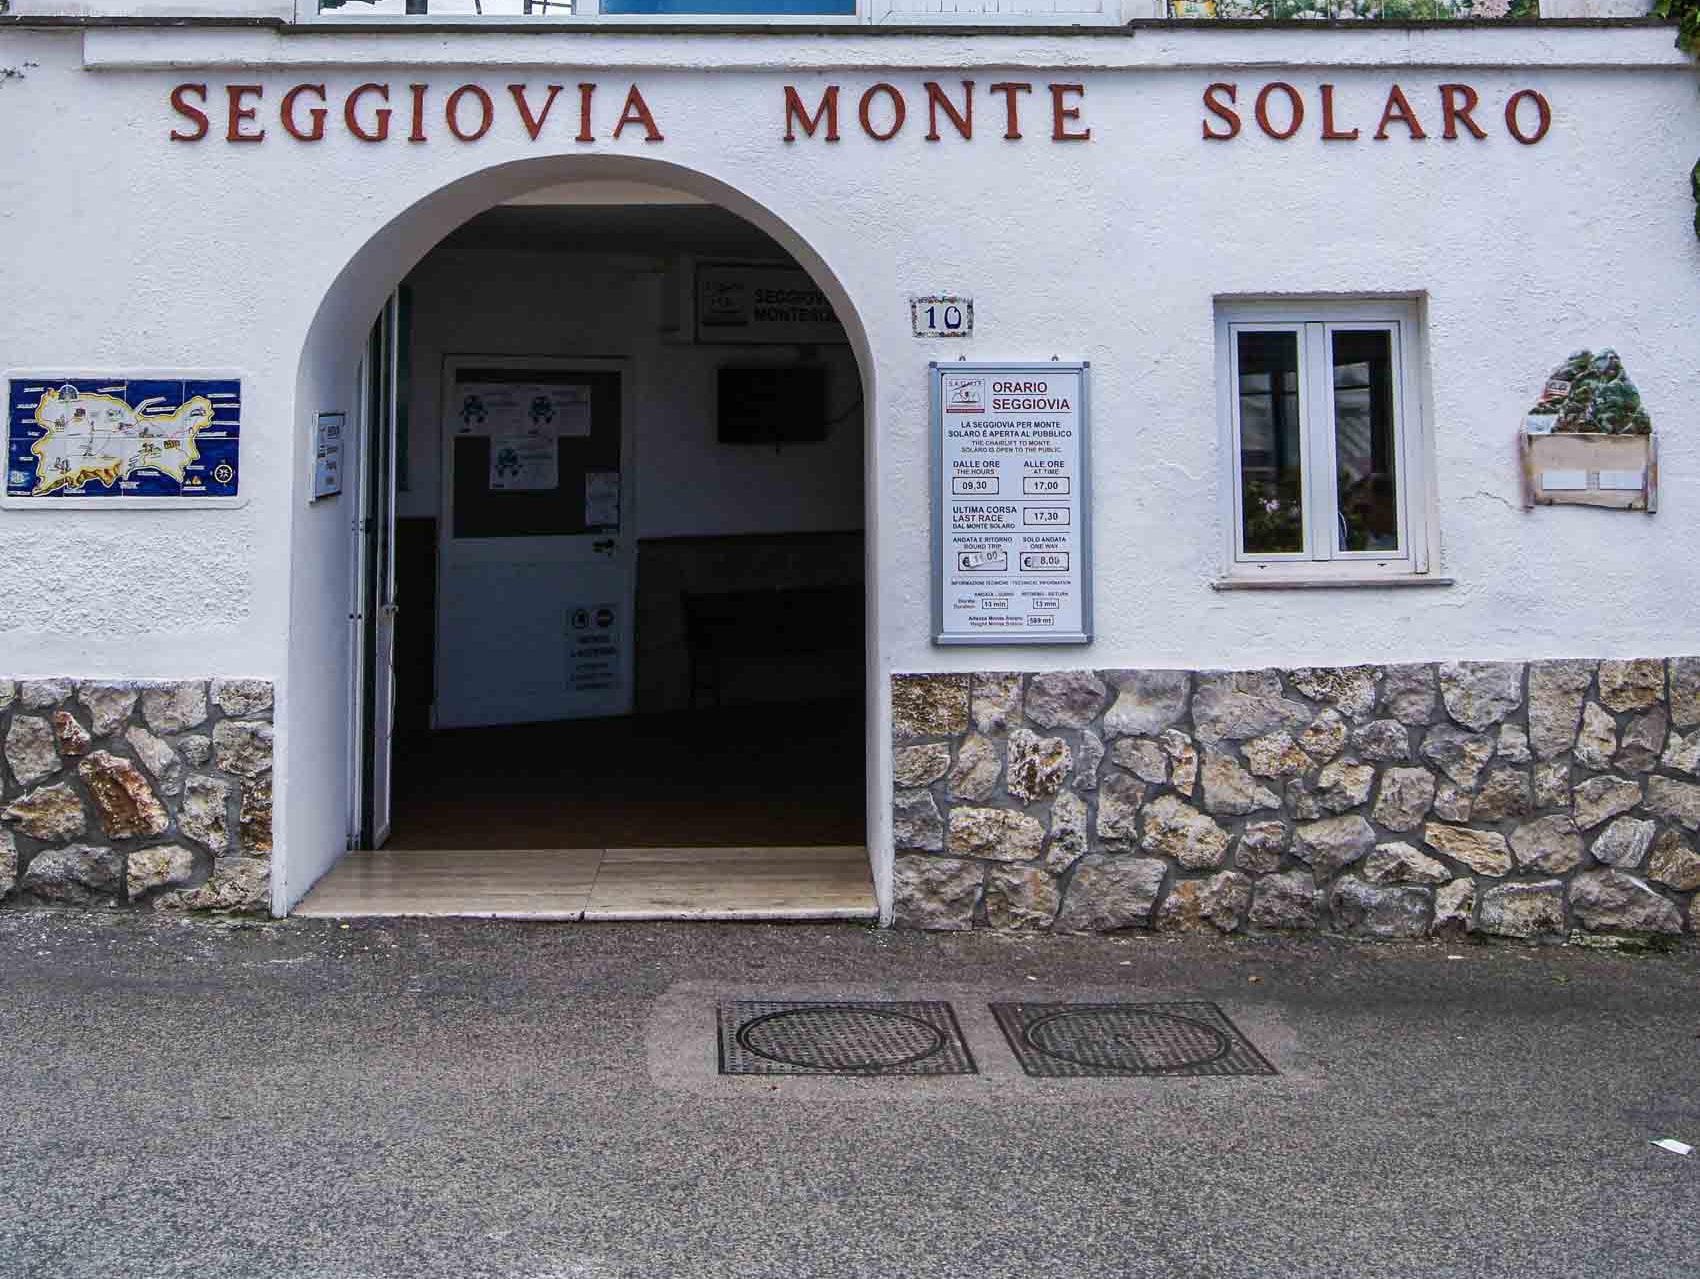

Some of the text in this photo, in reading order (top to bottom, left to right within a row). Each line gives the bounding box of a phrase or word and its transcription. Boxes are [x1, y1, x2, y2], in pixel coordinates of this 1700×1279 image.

[169, 80, 1552, 146] SEGGIOVIA MONTE SOLARO
[924, 305, 962, 330] 10
[992, 382, 1048, 393] ORARIO
[992, 398, 1070, 410] SEGGIOVIA
